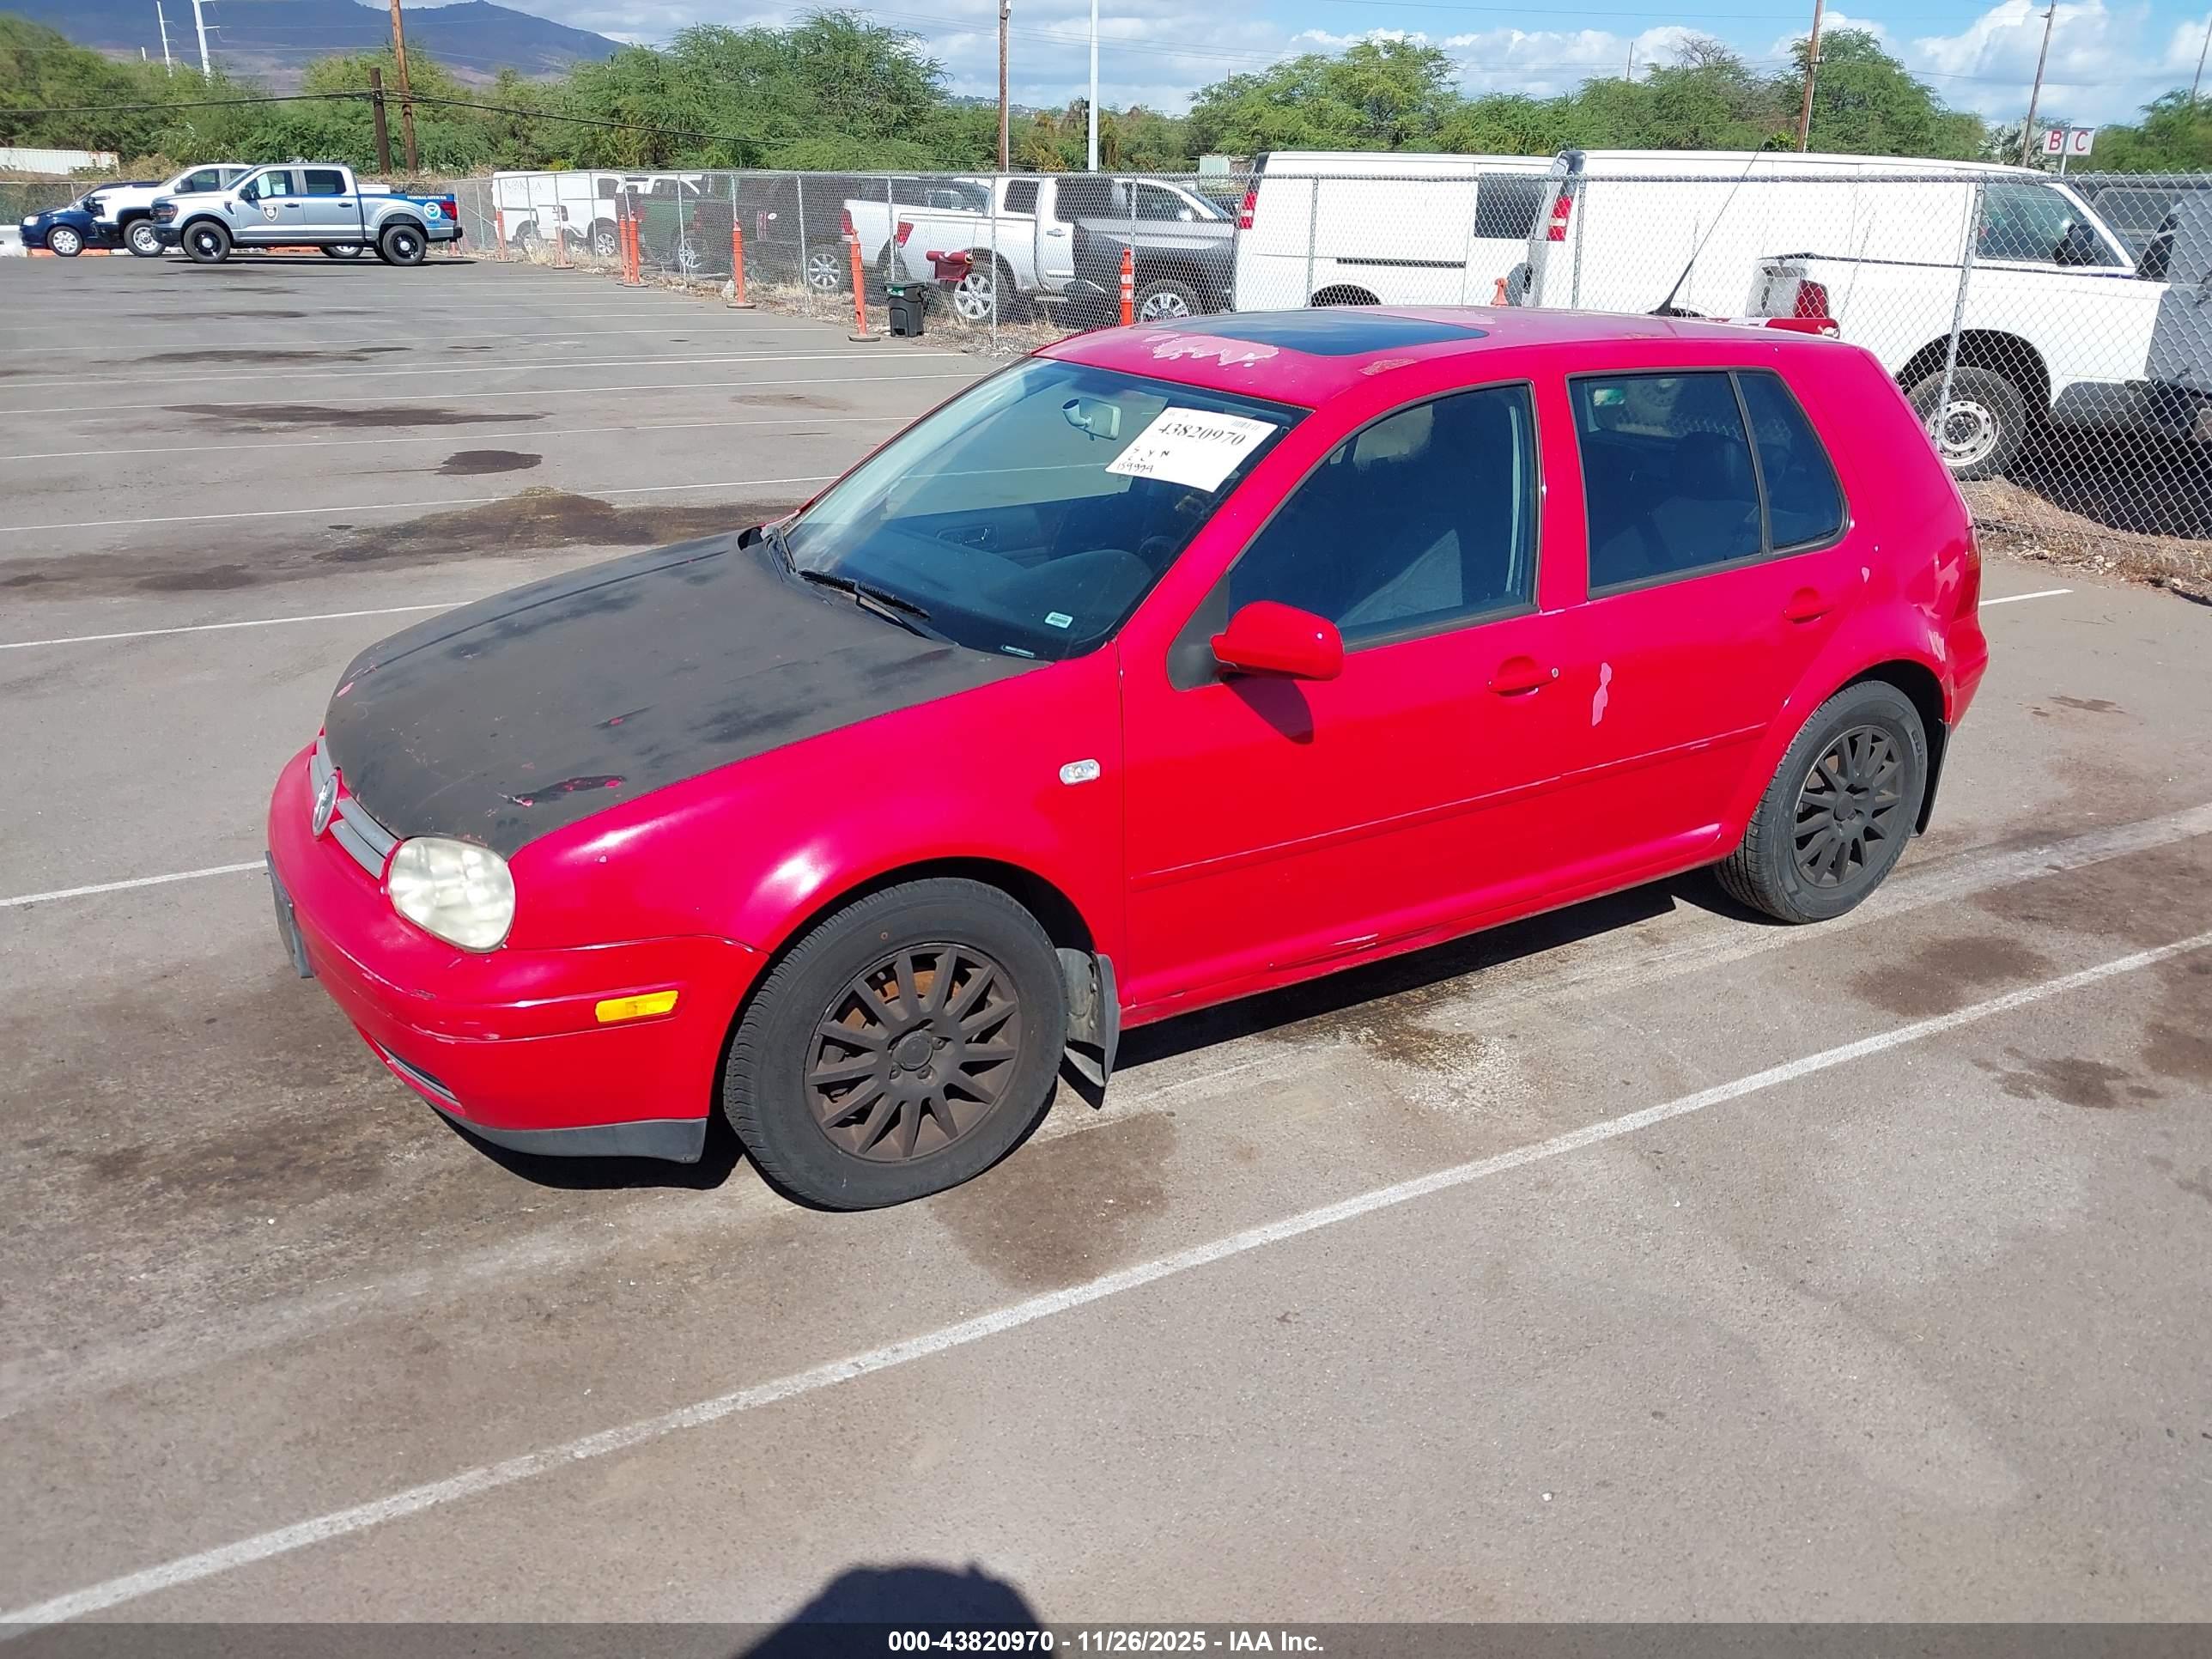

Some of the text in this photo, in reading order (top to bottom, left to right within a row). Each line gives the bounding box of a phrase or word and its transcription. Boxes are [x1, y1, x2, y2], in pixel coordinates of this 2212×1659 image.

[2048, 130, 2062, 151] B
[2075, 130, 2088, 152] C
[1158, 422, 1247, 446] 43820970
